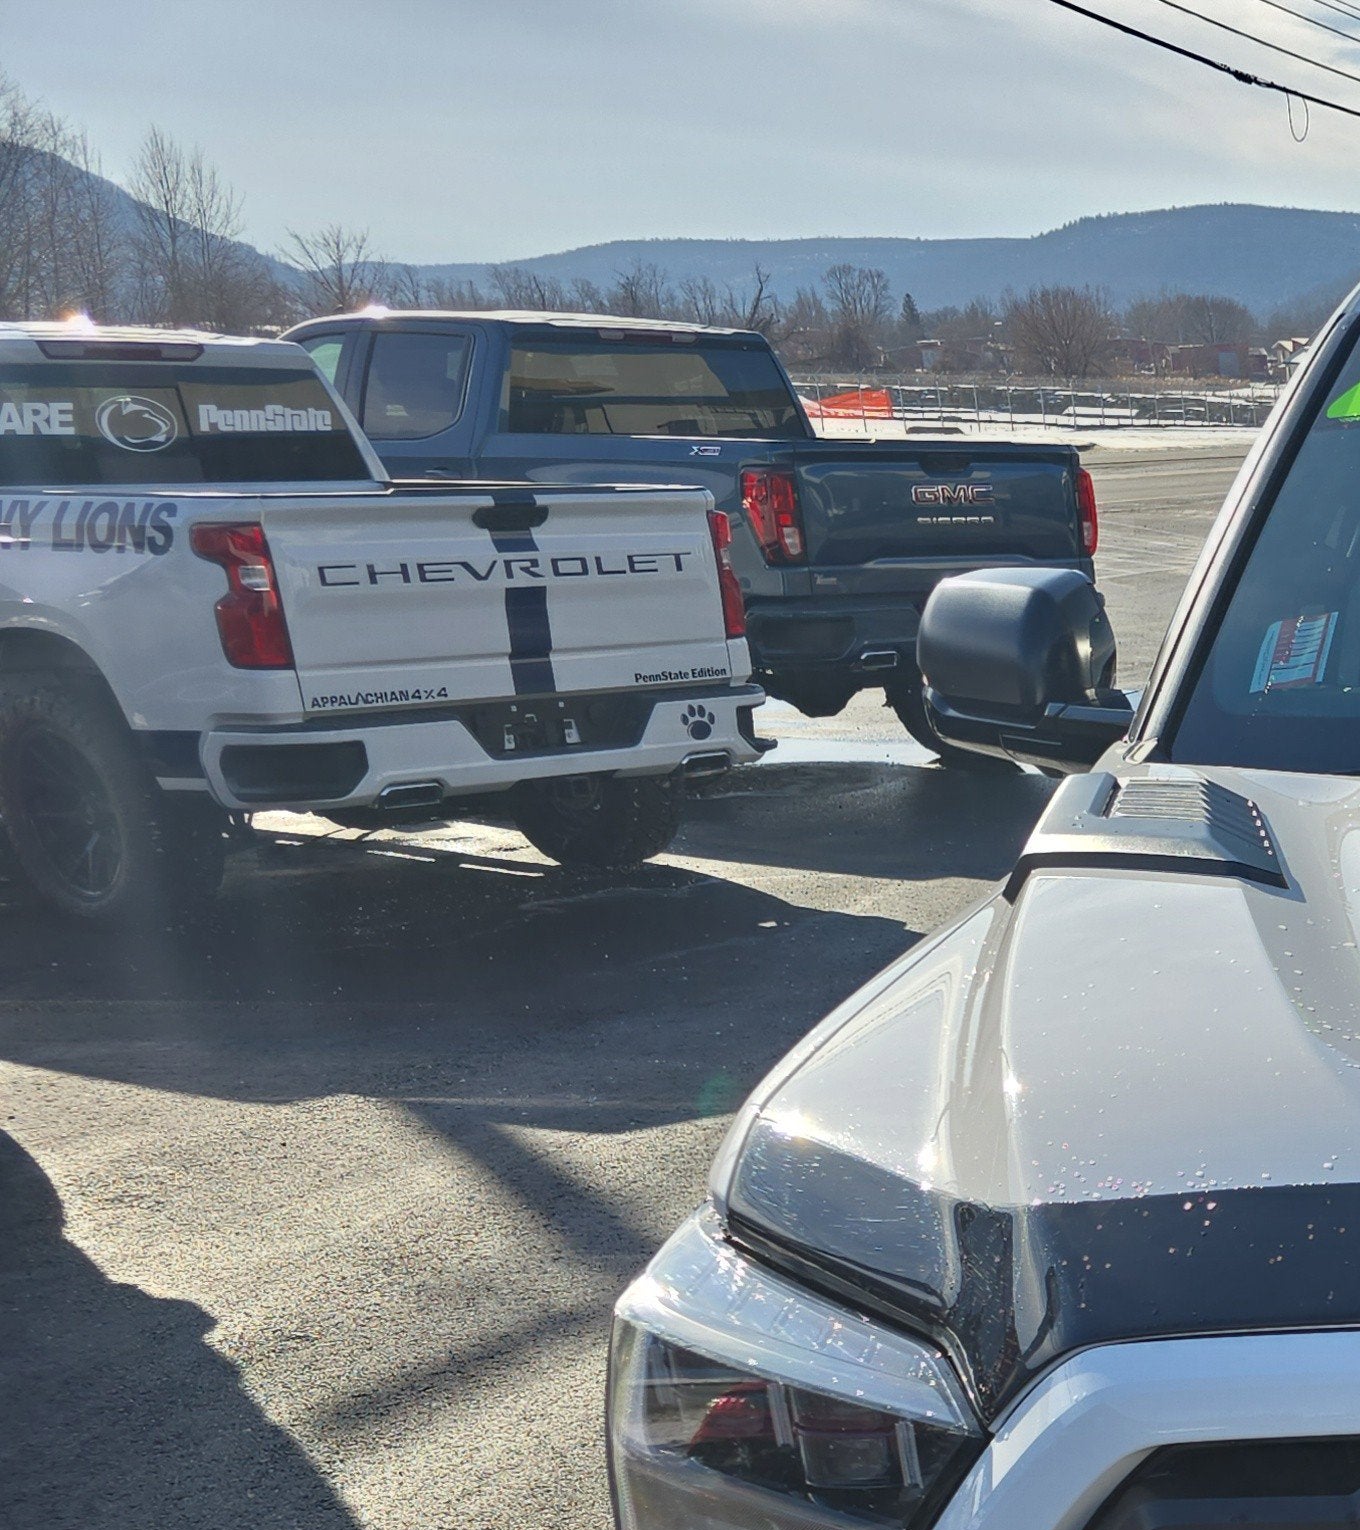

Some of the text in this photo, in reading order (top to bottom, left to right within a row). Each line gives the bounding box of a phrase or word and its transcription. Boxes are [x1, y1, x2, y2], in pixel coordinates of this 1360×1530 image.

[0, 402, 332, 435] ARE PennState
[912, 485, 996, 506] GMC
[52, 501, 177, 556] LIONS
[317, 552, 691, 586] CHEVROLET
[634, 667, 727, 682] PennState Edition
